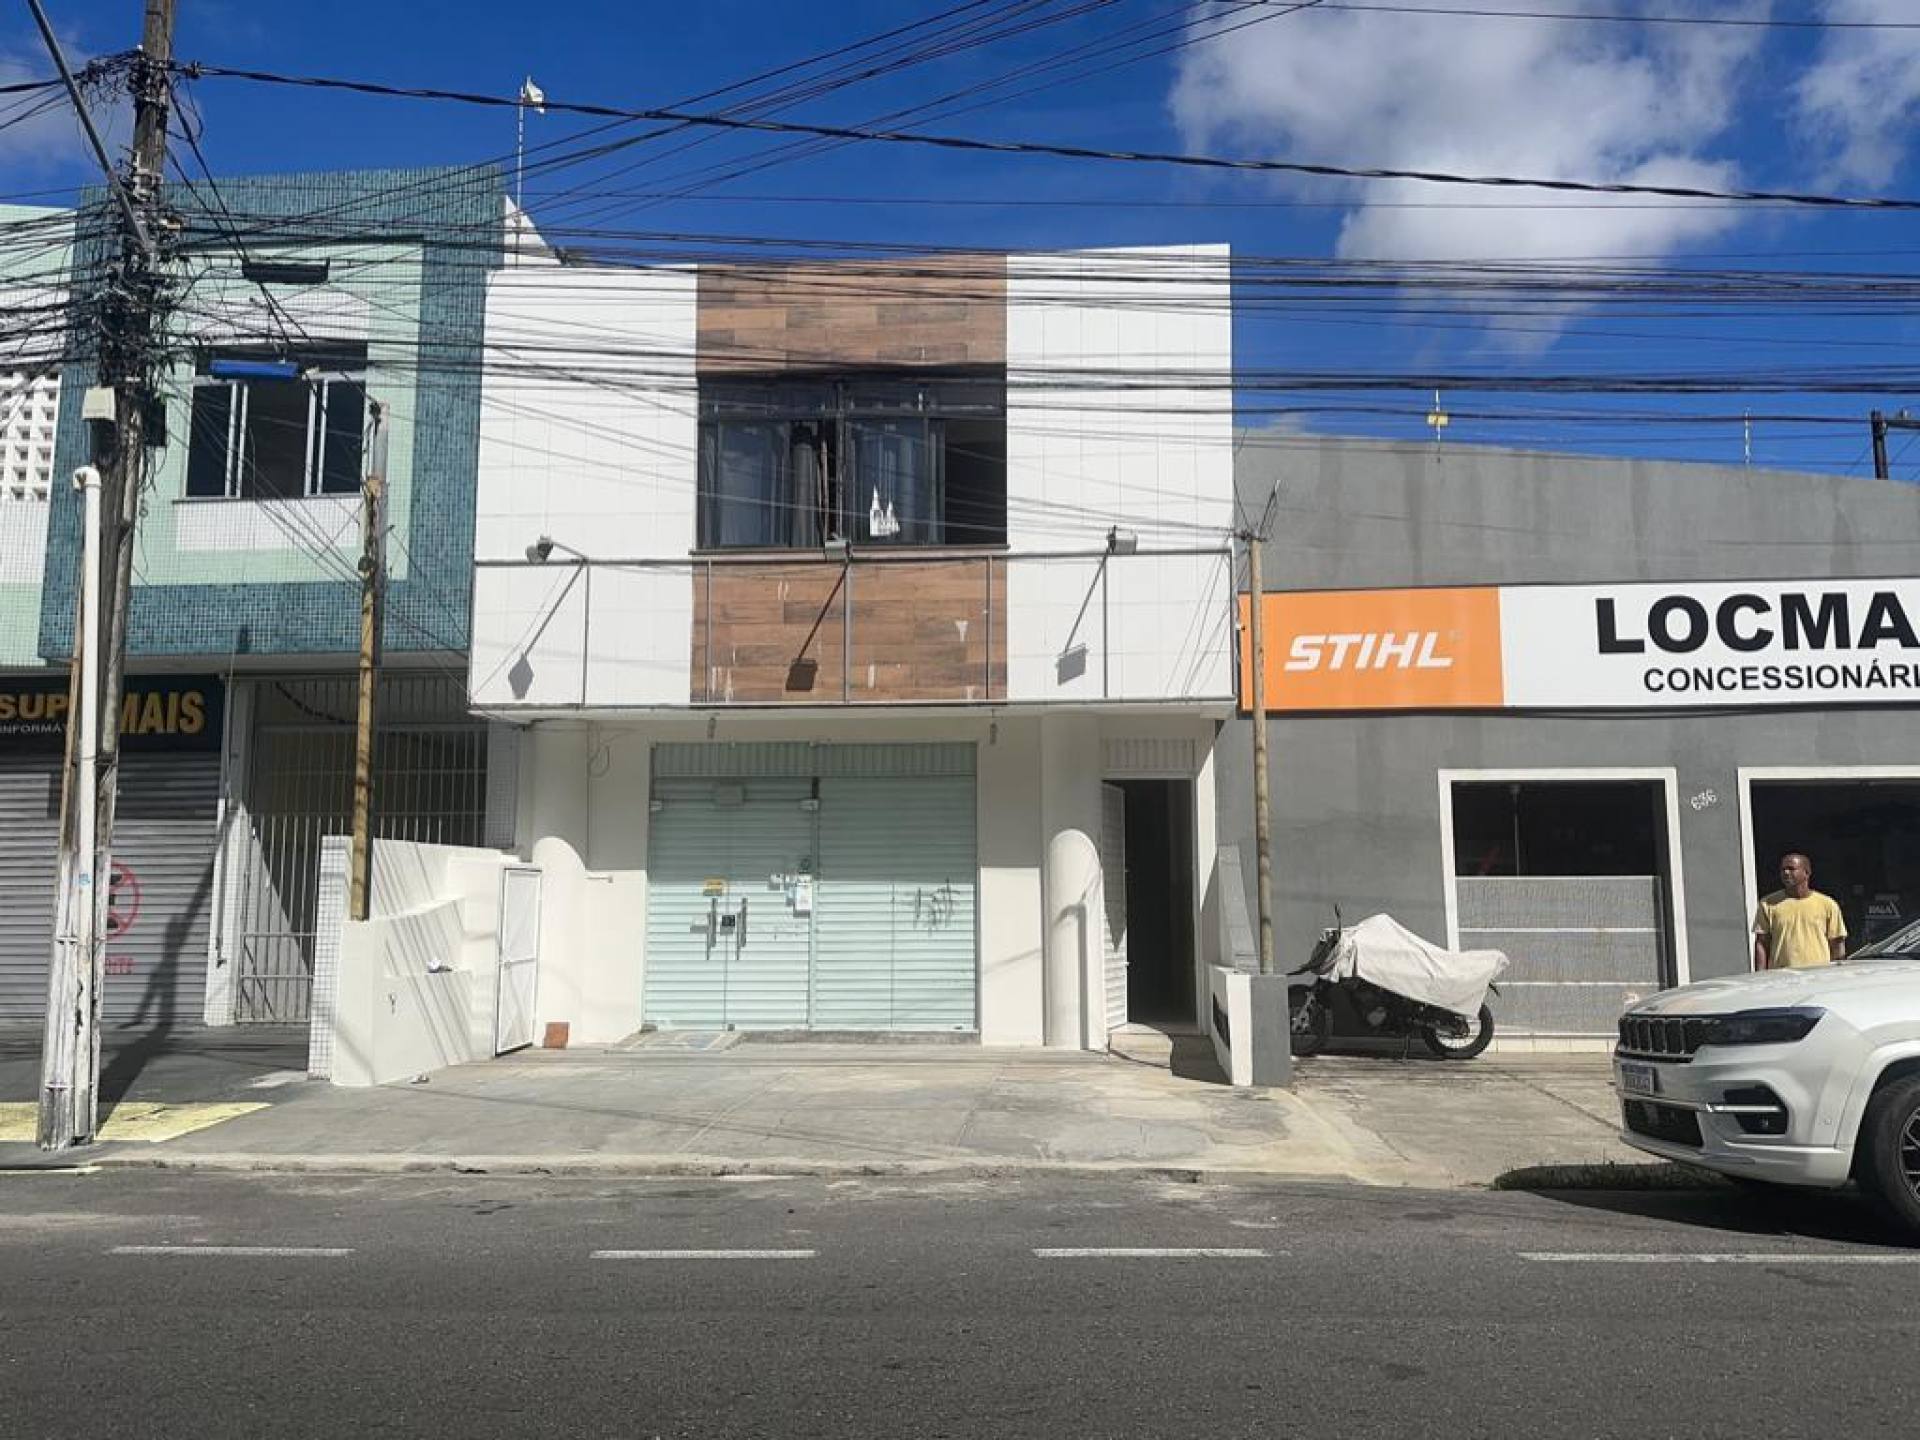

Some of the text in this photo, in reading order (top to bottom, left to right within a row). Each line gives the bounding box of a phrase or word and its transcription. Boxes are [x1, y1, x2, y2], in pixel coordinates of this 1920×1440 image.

[1595, 591, 1920, 654] LOCMA
[1284, 631, 1454, 672] STIHL
[1643, 657, 1920, 691] CONCESSIONÁRI
[0, 693, 69, 720] SUP
